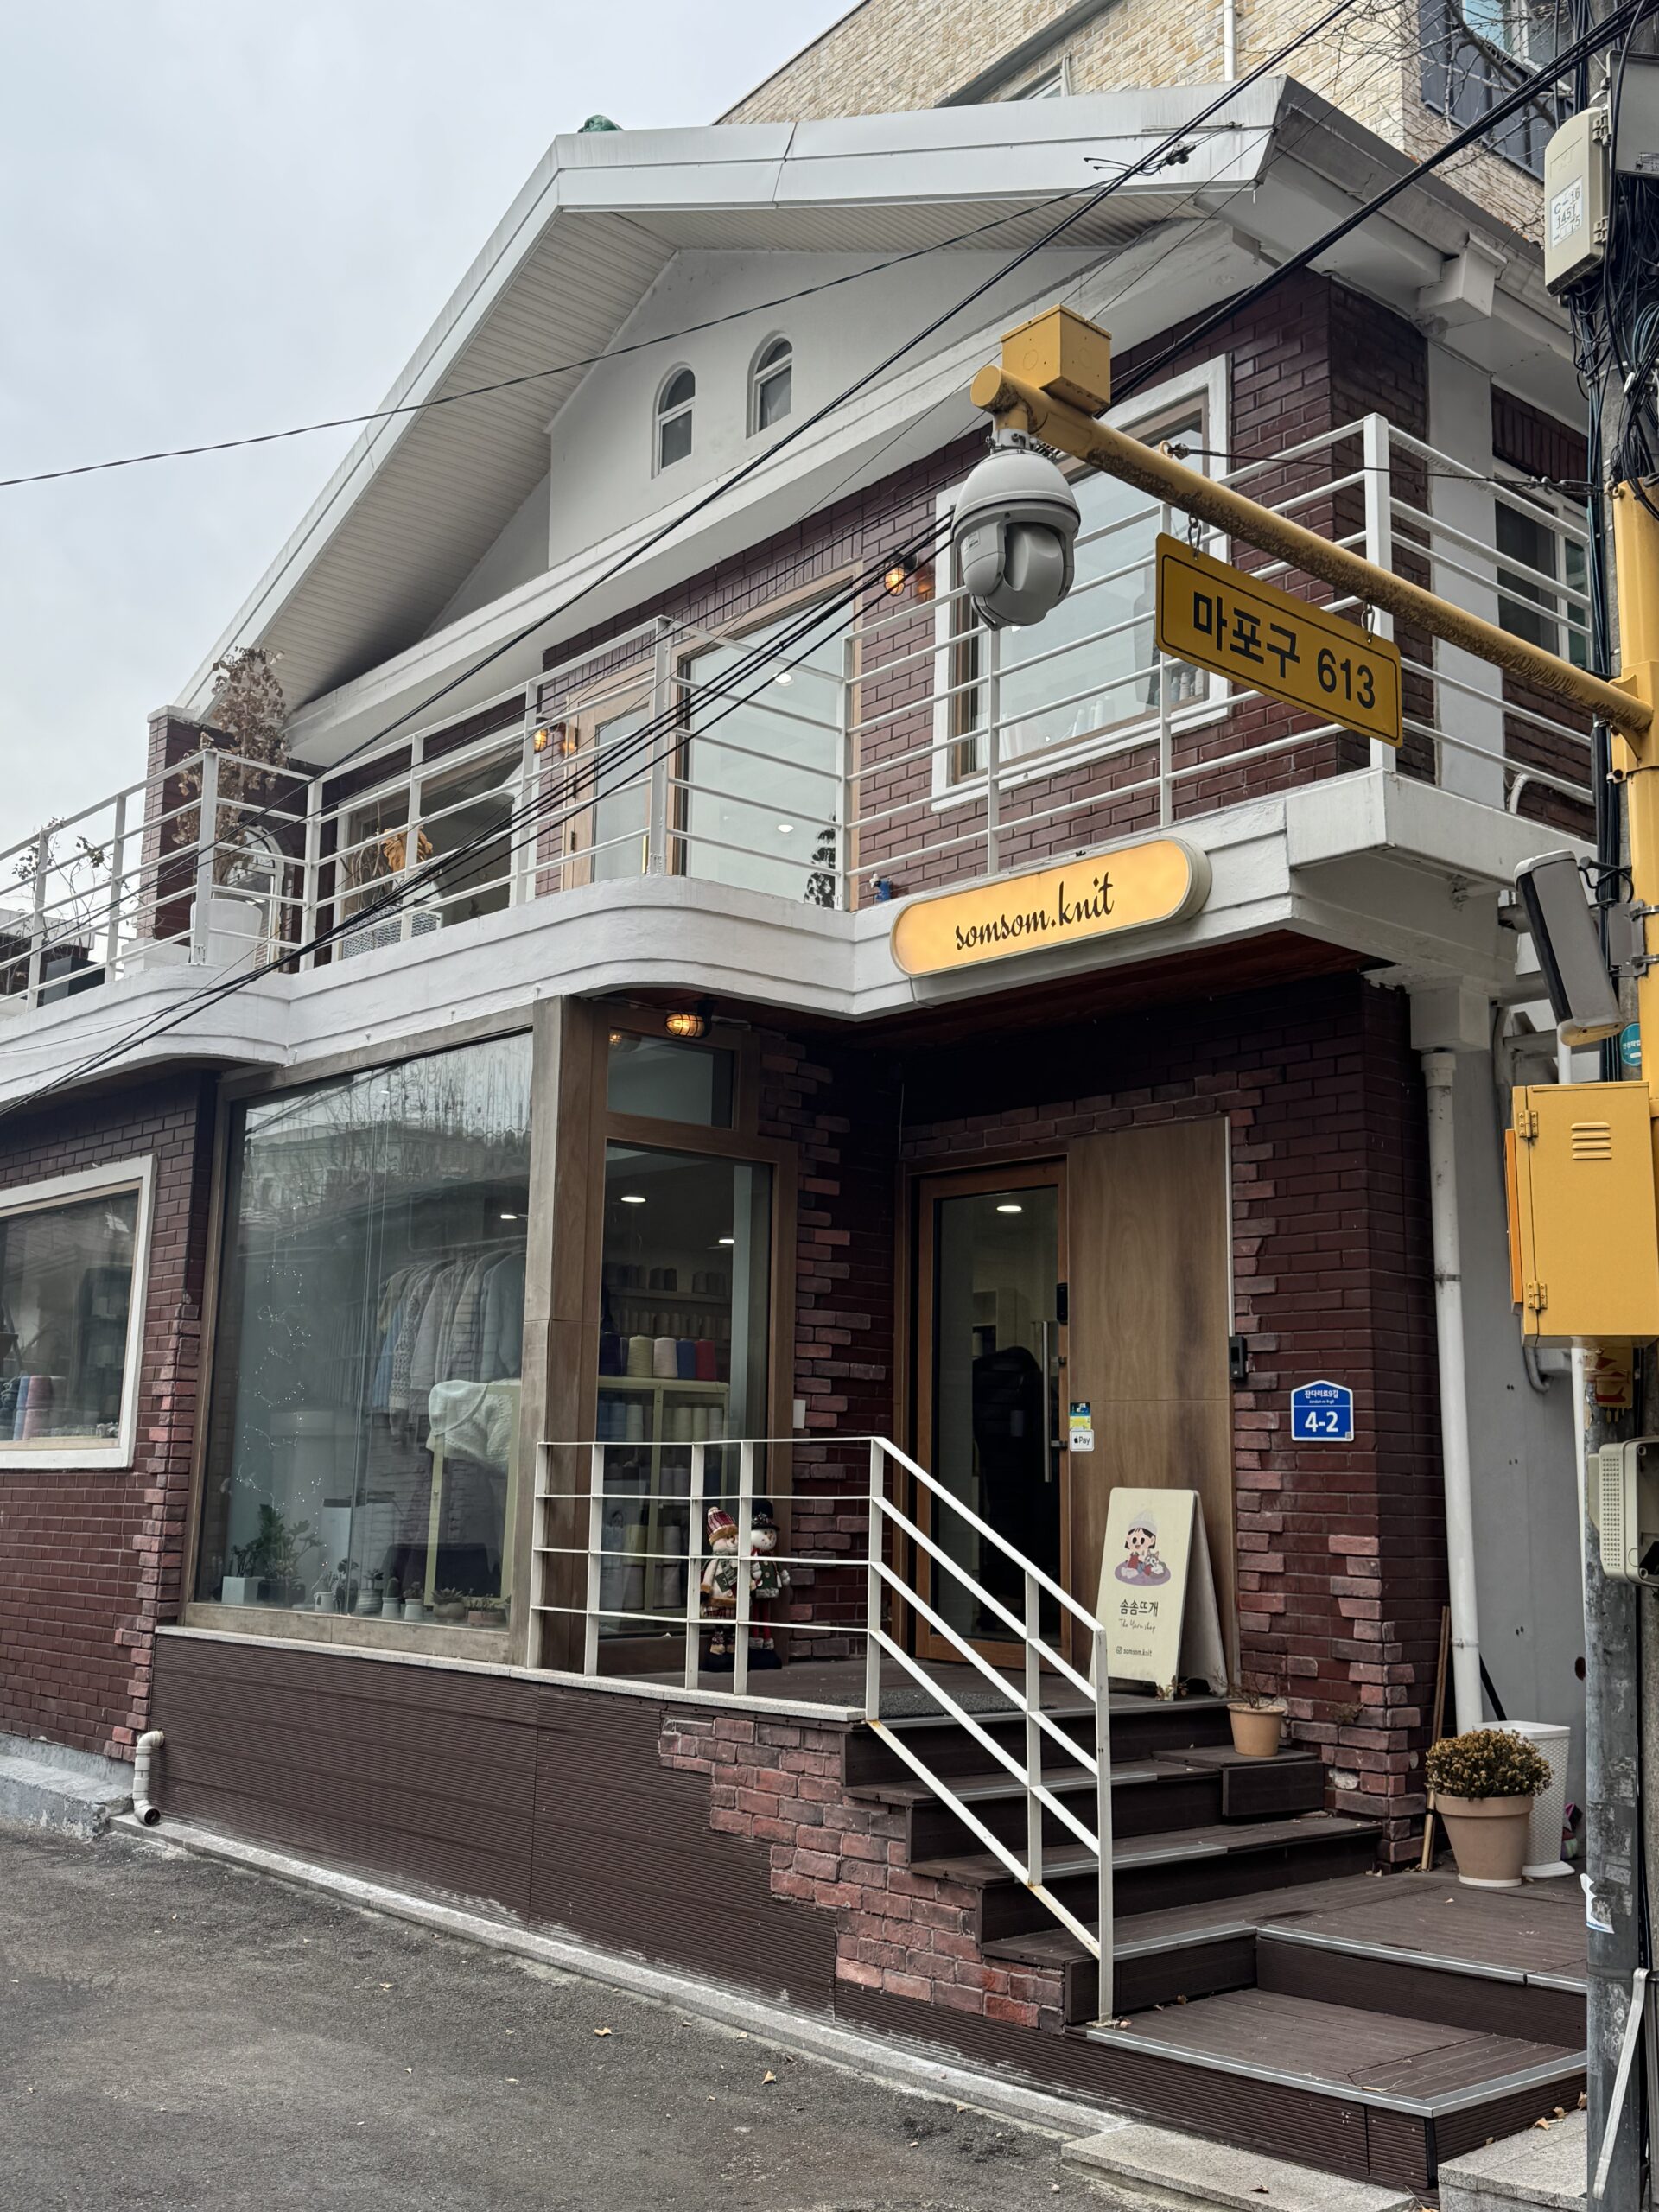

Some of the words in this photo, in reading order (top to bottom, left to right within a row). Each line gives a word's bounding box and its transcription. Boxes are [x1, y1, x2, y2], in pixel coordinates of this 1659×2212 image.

[1193, 591, 1300, 678] 마포구
[1317, 648, 1376, 709] 613
[955, 871, 1115, 950] somsom.knit
[1305, 1411, 1338, 1433] 4-2
[1078, 1436, 1090, 1446] Pay
[1120, 1599, 1159, 1617] 솜솜뜨개
